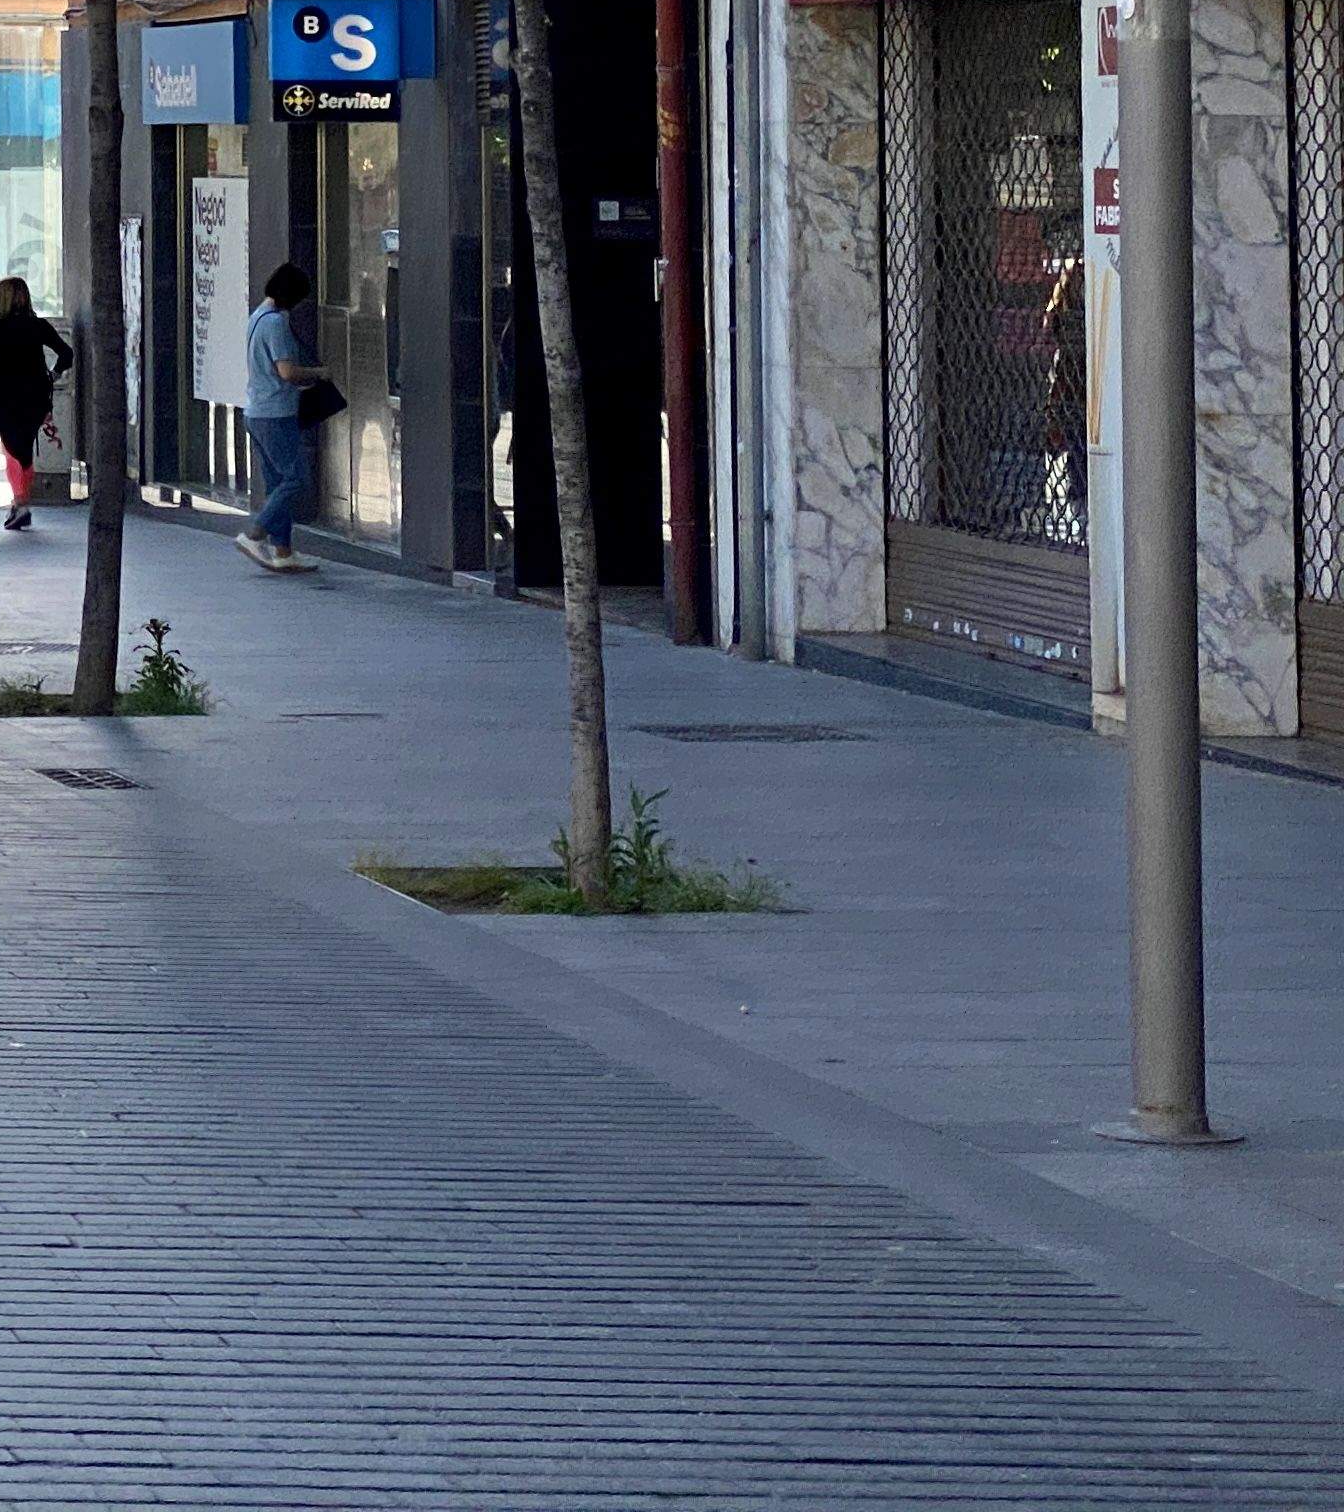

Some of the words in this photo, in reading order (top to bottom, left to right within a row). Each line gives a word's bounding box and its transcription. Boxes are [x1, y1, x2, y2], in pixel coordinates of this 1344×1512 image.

[303, 15, 320, 35] B
[330, 14, 377, 72] S
[318, 91, 392, 110] ServiRed
[194, 187, 226, 235] Negoci
